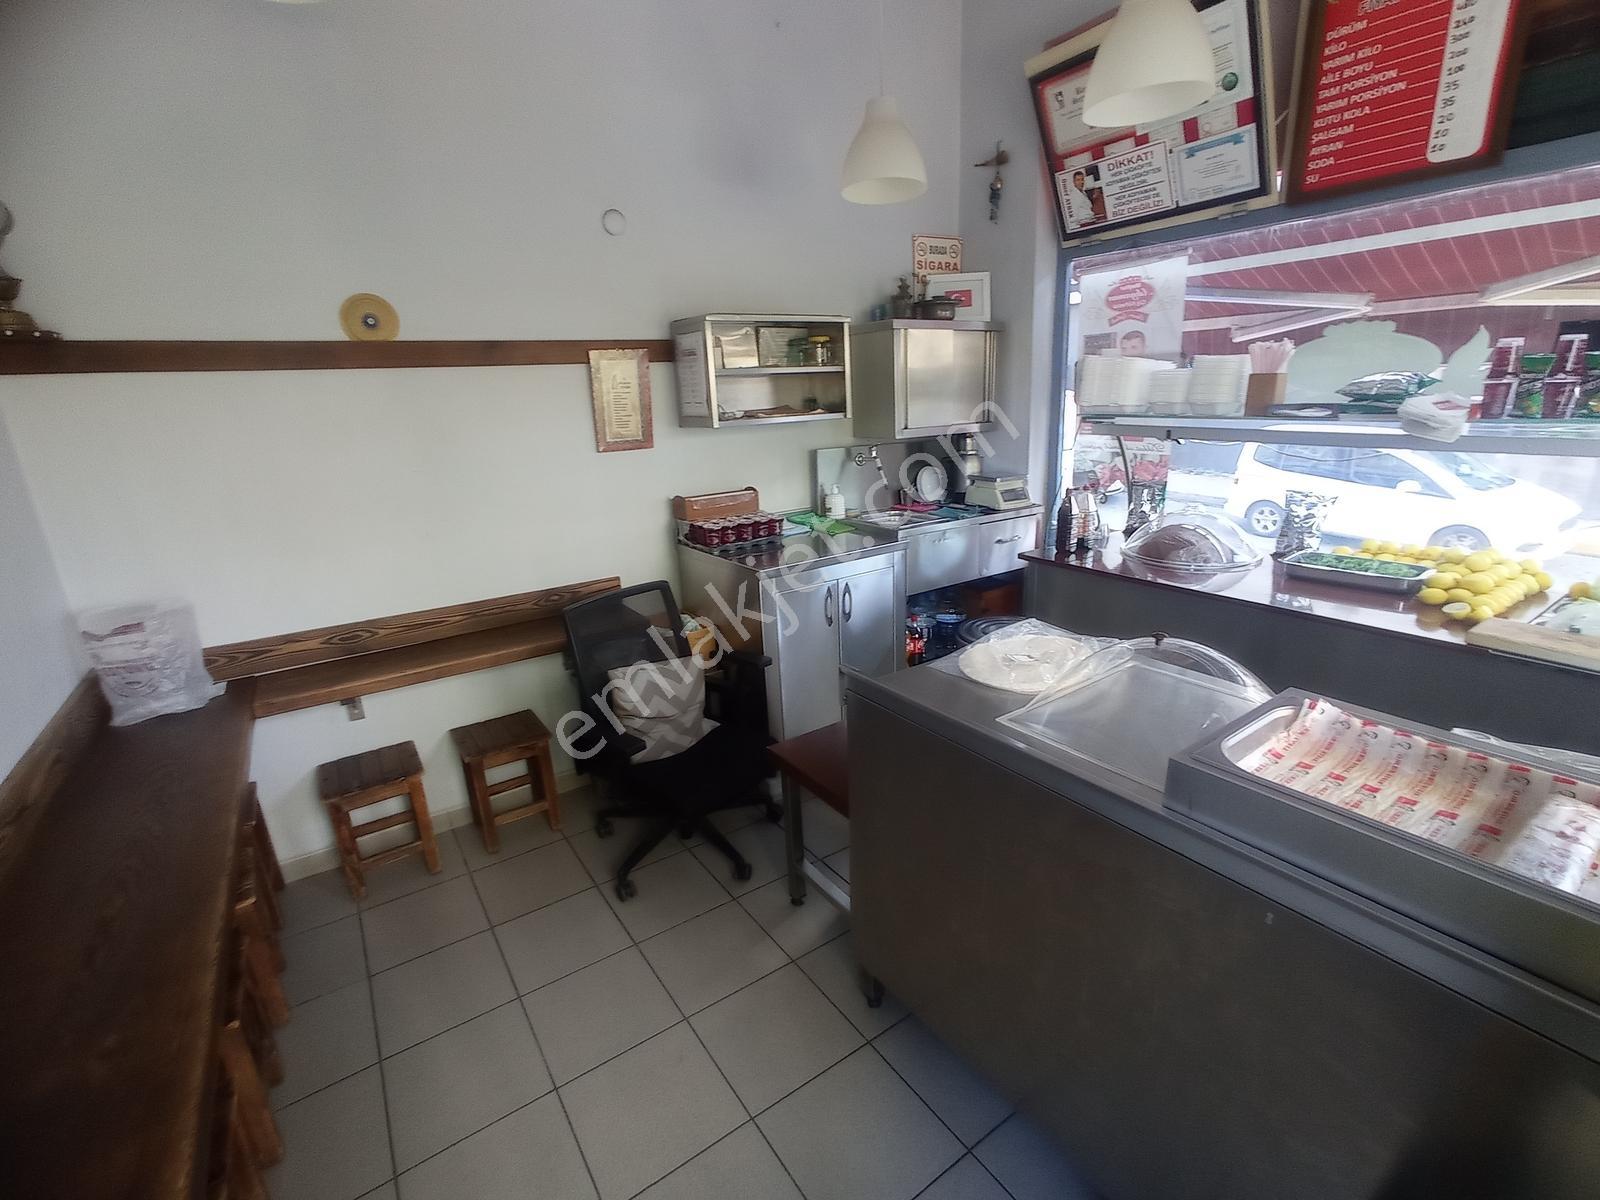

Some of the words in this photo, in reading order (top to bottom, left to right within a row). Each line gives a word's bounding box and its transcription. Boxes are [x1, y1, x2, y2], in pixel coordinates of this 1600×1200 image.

[1326, 19, 1368, 41] DÜRÜM
[1322, 53, 1355, 70] YARIM
[1355, 45, 1382, 61] KİLO
[1324, 41, 1347, 56] KİLO
[1318, 85, 1341, 99] TAM
[1342, 68, 1398, 93] PORSİYON
[1320, 70, 1341, 85] AİLE
[1342, 62, 1374, 79] BOYU
[1316, 97, 1349, 114] YARIM
[1350, 81, 1408, 105] PORSİYON
[1313, 114, 1341, 128] KUTU
[1343, 106, 1371, 122] KOLA
[1311, 124, 1355, 144] ŞALGAM
[1309, 141, 1344, 156] AYRAN
[1107, 150, 1154, 171] DİKKAT!
[1307, 157, 1335, 171] SODA
[1305, 174, 1319, 185] SU
[916, 257, 960, 272] SİGARA
